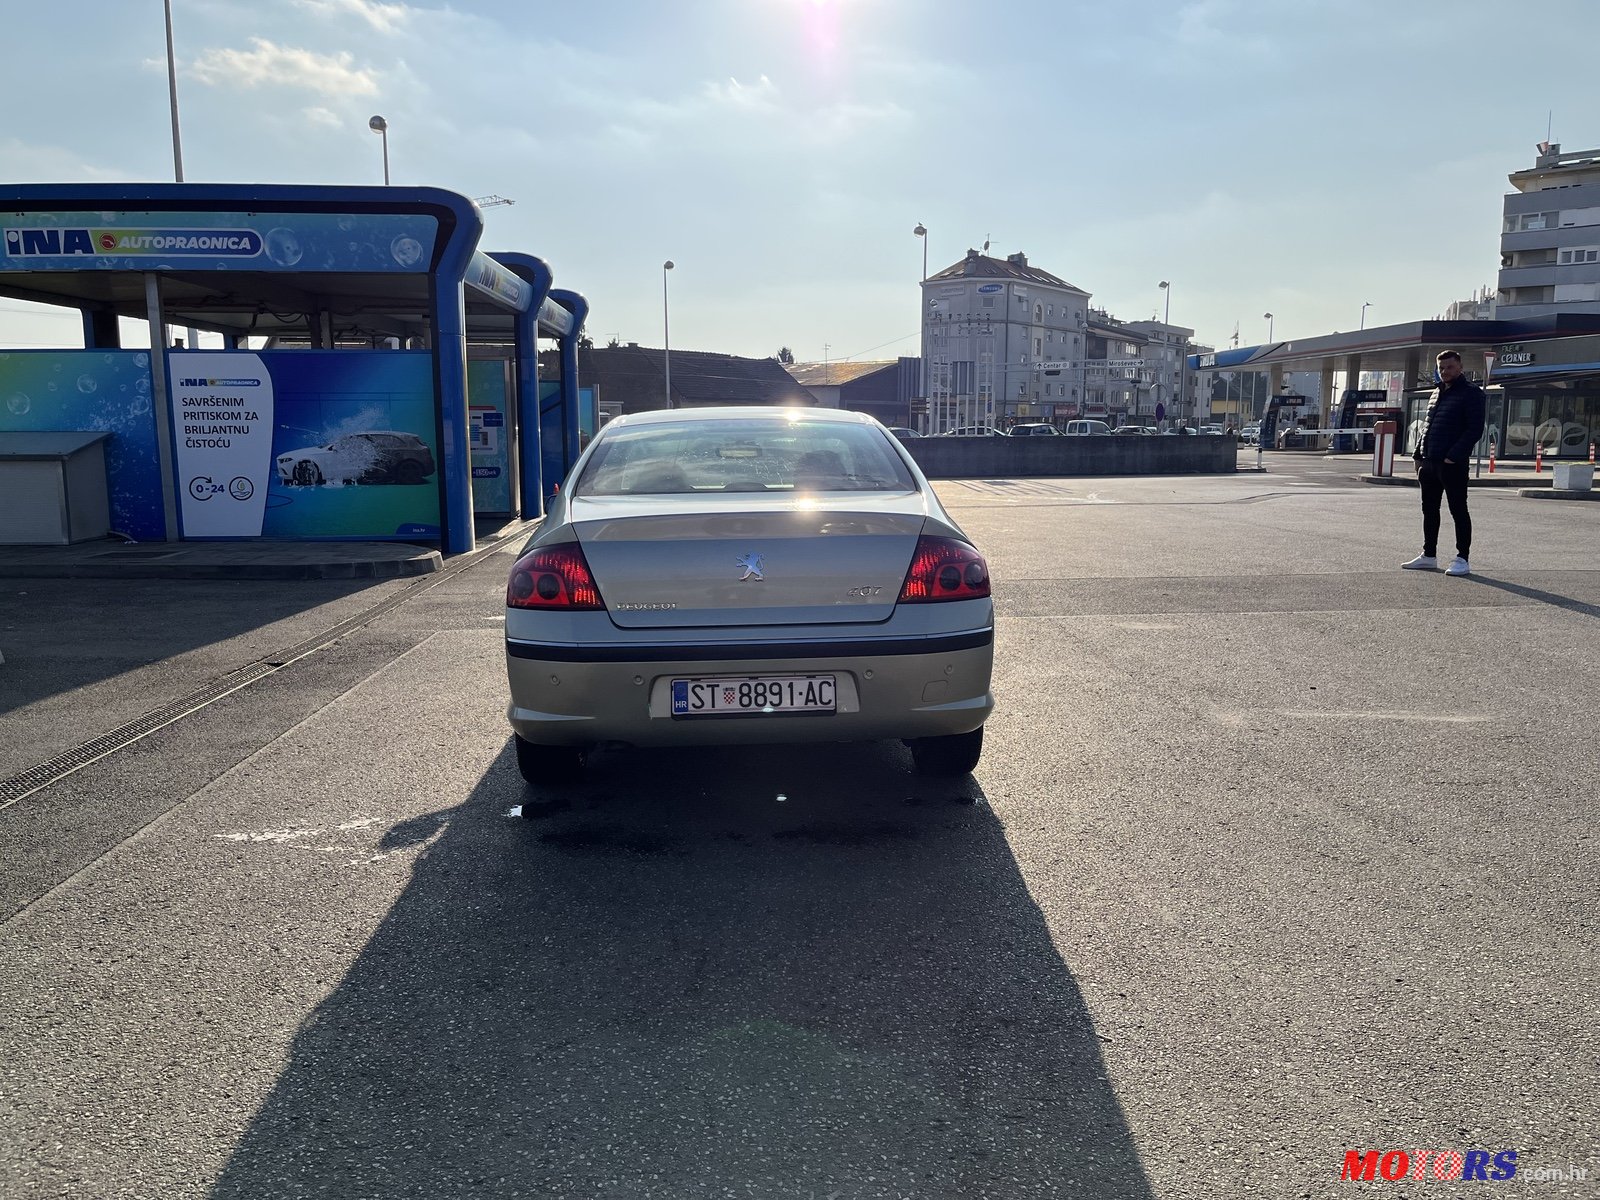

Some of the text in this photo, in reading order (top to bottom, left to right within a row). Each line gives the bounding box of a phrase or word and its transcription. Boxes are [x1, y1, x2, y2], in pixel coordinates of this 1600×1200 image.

[118, 236, 251, 250] AUTOPRAONICA
[182, 395, 244, 407] SAVRŠENIM
[183, 411, 259, 421] PRITISKOM ZA
[184, 425, 249, 435] BRILJANTNU
[185, 437, 231, 448] ČISTOĆU
[847, 585, 883, 596] 407
[616, 602, 678, 610] PEUGEOT
[691, 683, 720, 709] ST
[675, 701, 688, 709] HR
